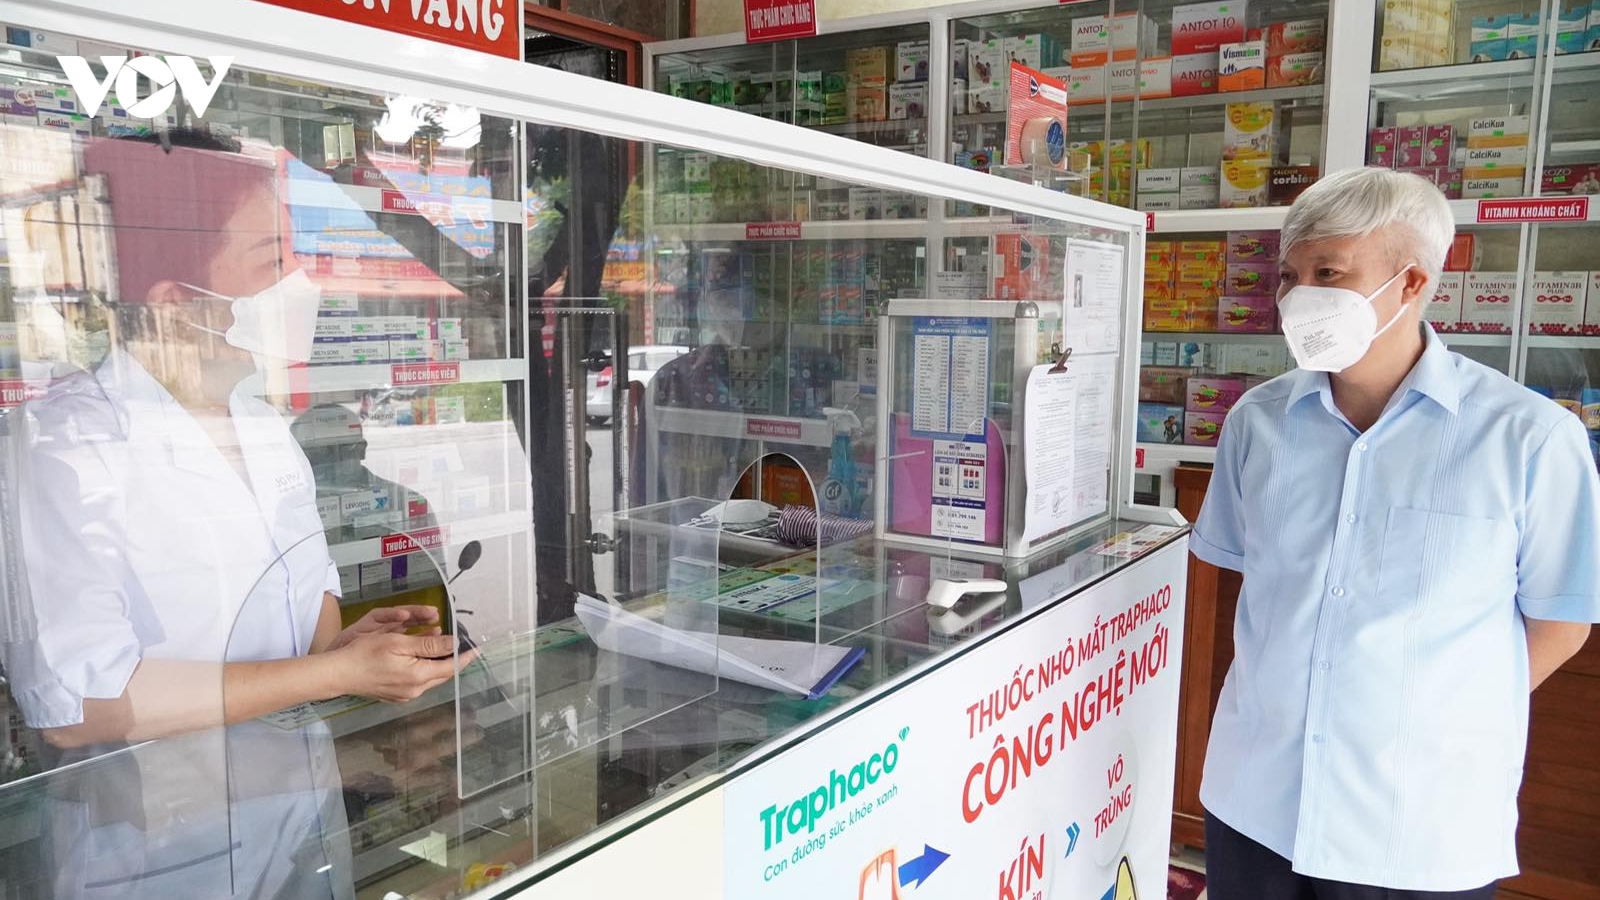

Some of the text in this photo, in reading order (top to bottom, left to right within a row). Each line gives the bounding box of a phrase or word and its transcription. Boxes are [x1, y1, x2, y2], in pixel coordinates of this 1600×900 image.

[1077, 24, 1104, 35] ANTOT
[1180, 18, 1218, 32] ANTOT
[1473, 120, 1505, 130] CalciKua
[1469, 150, 1501, 159] CalciKua
[1467, 181, 1499, 190] CalciKua
[1485, 202, 1580, 218] VITAMIN KHOÁNG CHẤT
[1470, 282, 1507, 290] VITAMIN
[395, 367, 457, 382] THUỐC CHỐNG VIÊM
[826, 484, 840, 499] Cif
[386, 537, 407, 552] THUỐC
[966, 583, 1171, 740] THUỐC NHỎ MẮT TRAPHACO
[962, 622, 1169, 824] CÔNG NGHỆ MỚI
[1107, 753, 1124, 790] VÔ
[759, 743, 899, 852] Traphaco
[1094, 783, 1132, 839] TRÙNG
[763, 784, 898, 882] Con đường sức khỏe xanh
[998, 833, 1045, 900] KÍN
